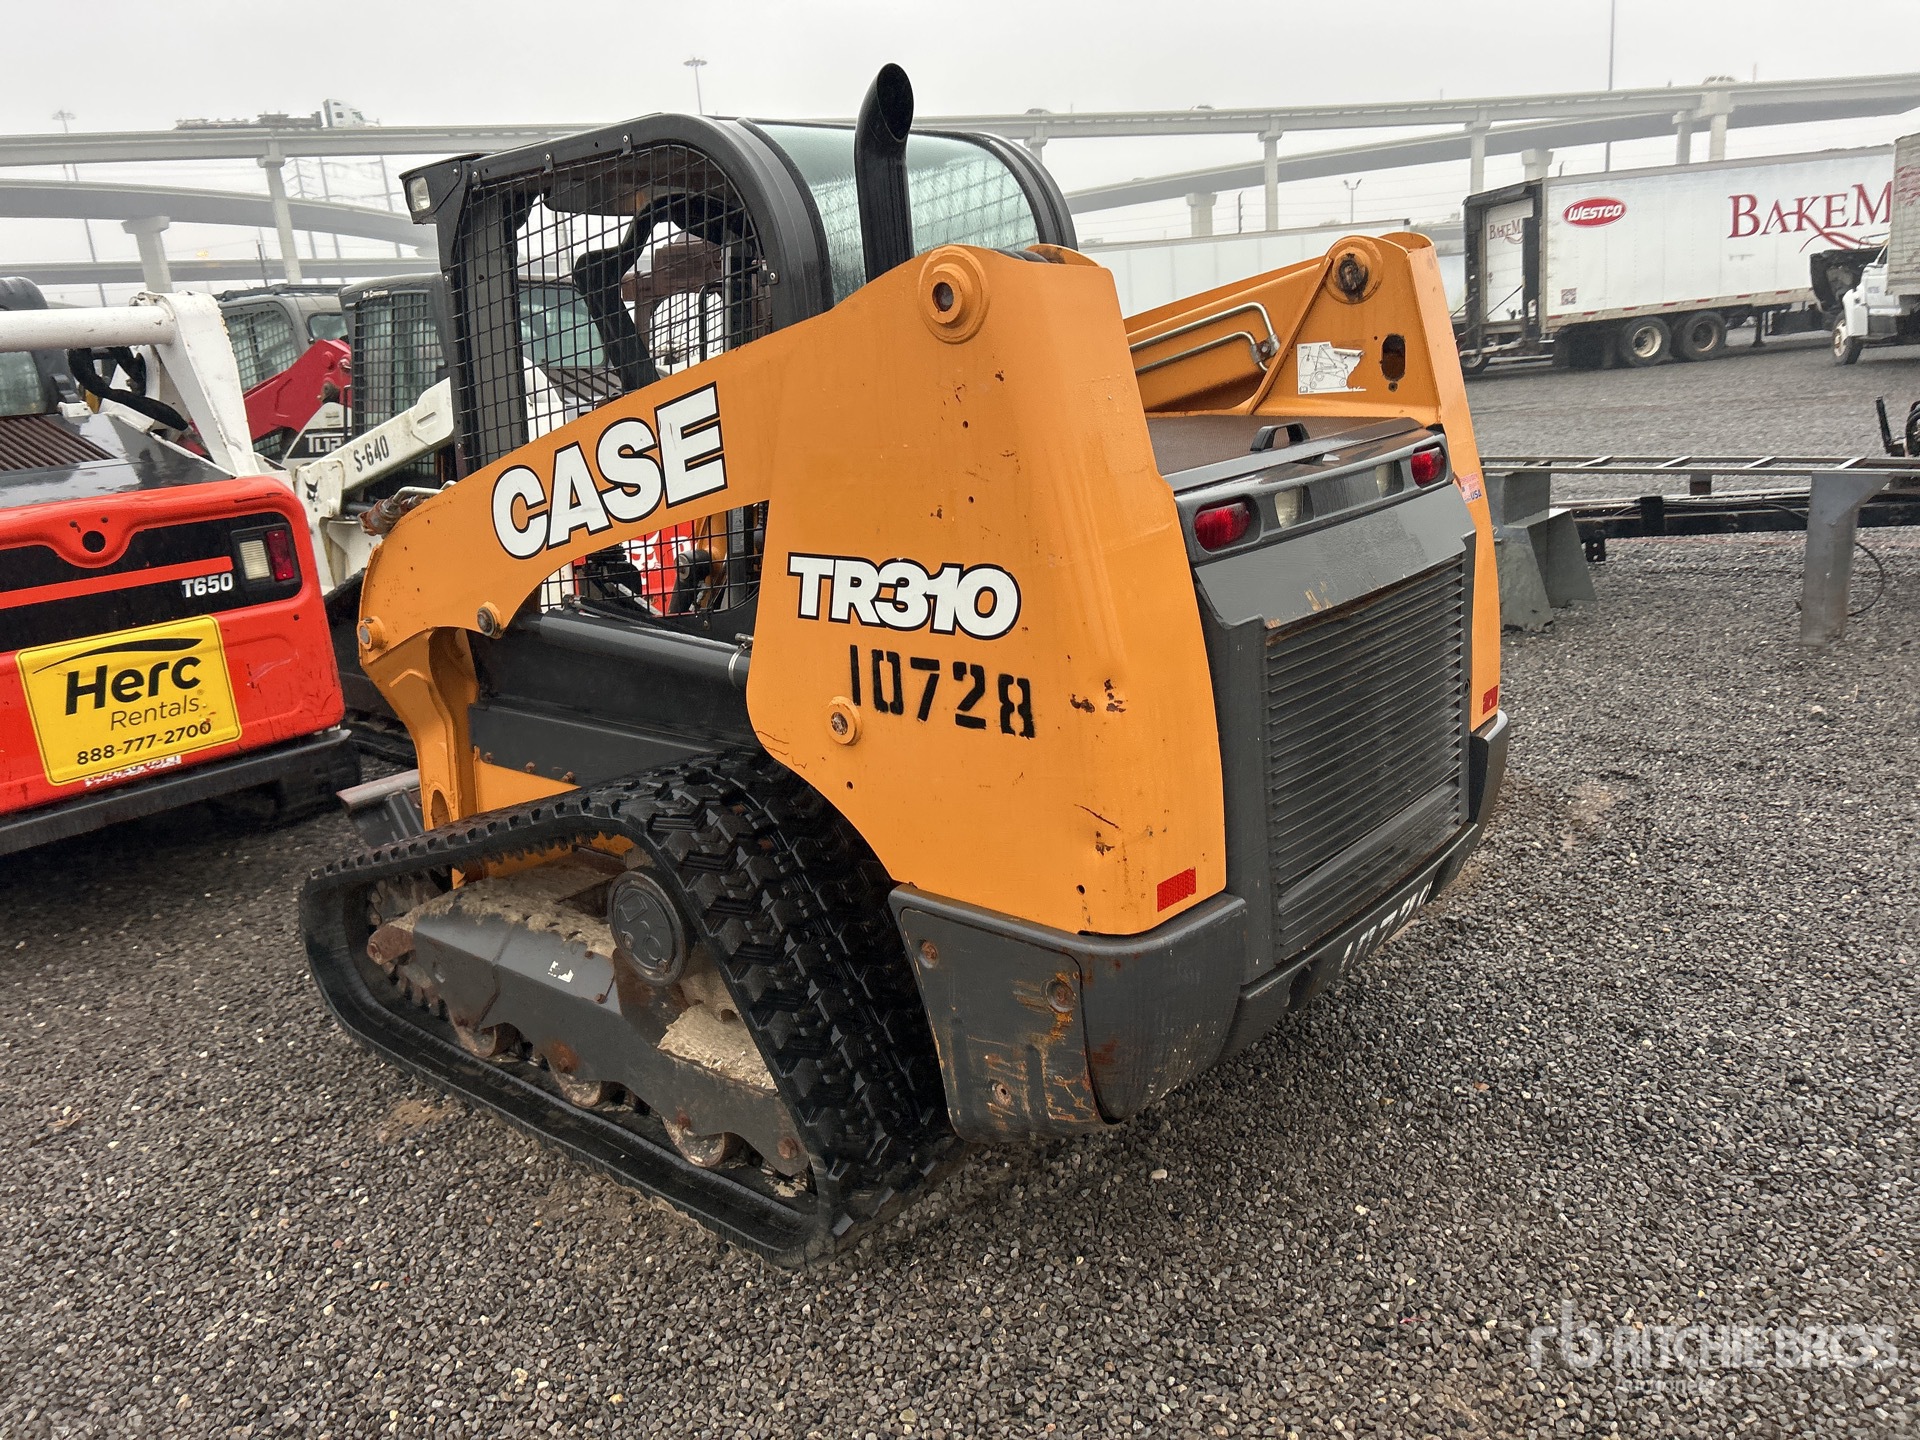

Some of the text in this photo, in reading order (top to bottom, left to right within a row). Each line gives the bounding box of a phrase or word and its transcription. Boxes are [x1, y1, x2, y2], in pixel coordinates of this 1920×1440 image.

[1568, 205, 1623, 221] WESTCO
[353, 434, 390, 473] S-640
[491, 381, 728, 559] CASE
[182, 573, 234, 598] T650
[788, 552, 1021, 640] TR310
[65, 656, 201, 716] Herc
[849, 644, 1037, 740] 10728
[110, 694, 200, 731] Rentals
[77, 722, 212, 765] 888-777-2700
